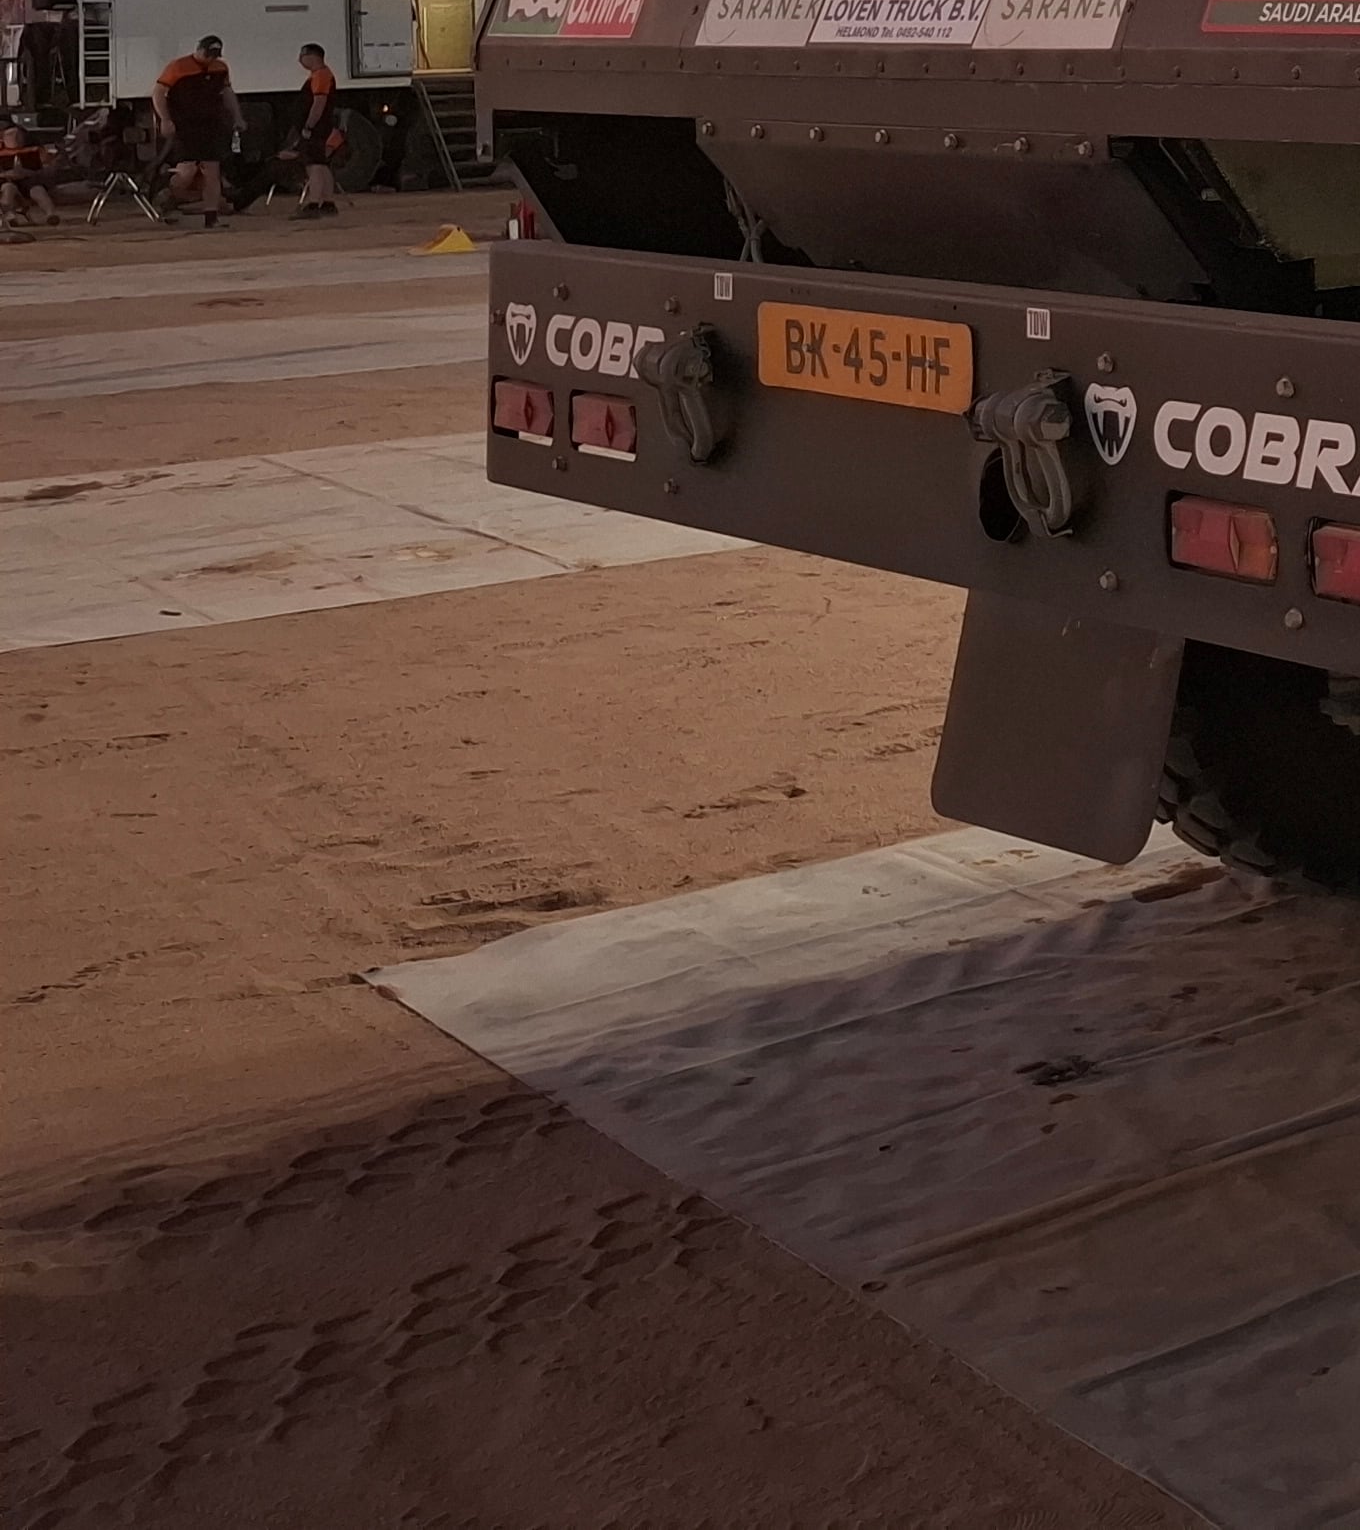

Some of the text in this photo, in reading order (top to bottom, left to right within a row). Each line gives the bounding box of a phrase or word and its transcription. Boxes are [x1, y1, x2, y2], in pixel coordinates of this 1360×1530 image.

[1259, 2, 1318, 23] SAUDI
[715, 274, 732, 298] TOW
[1028, 308, 1050, 337] TOW
[784, 318, 951, 396] BK-45-HF
